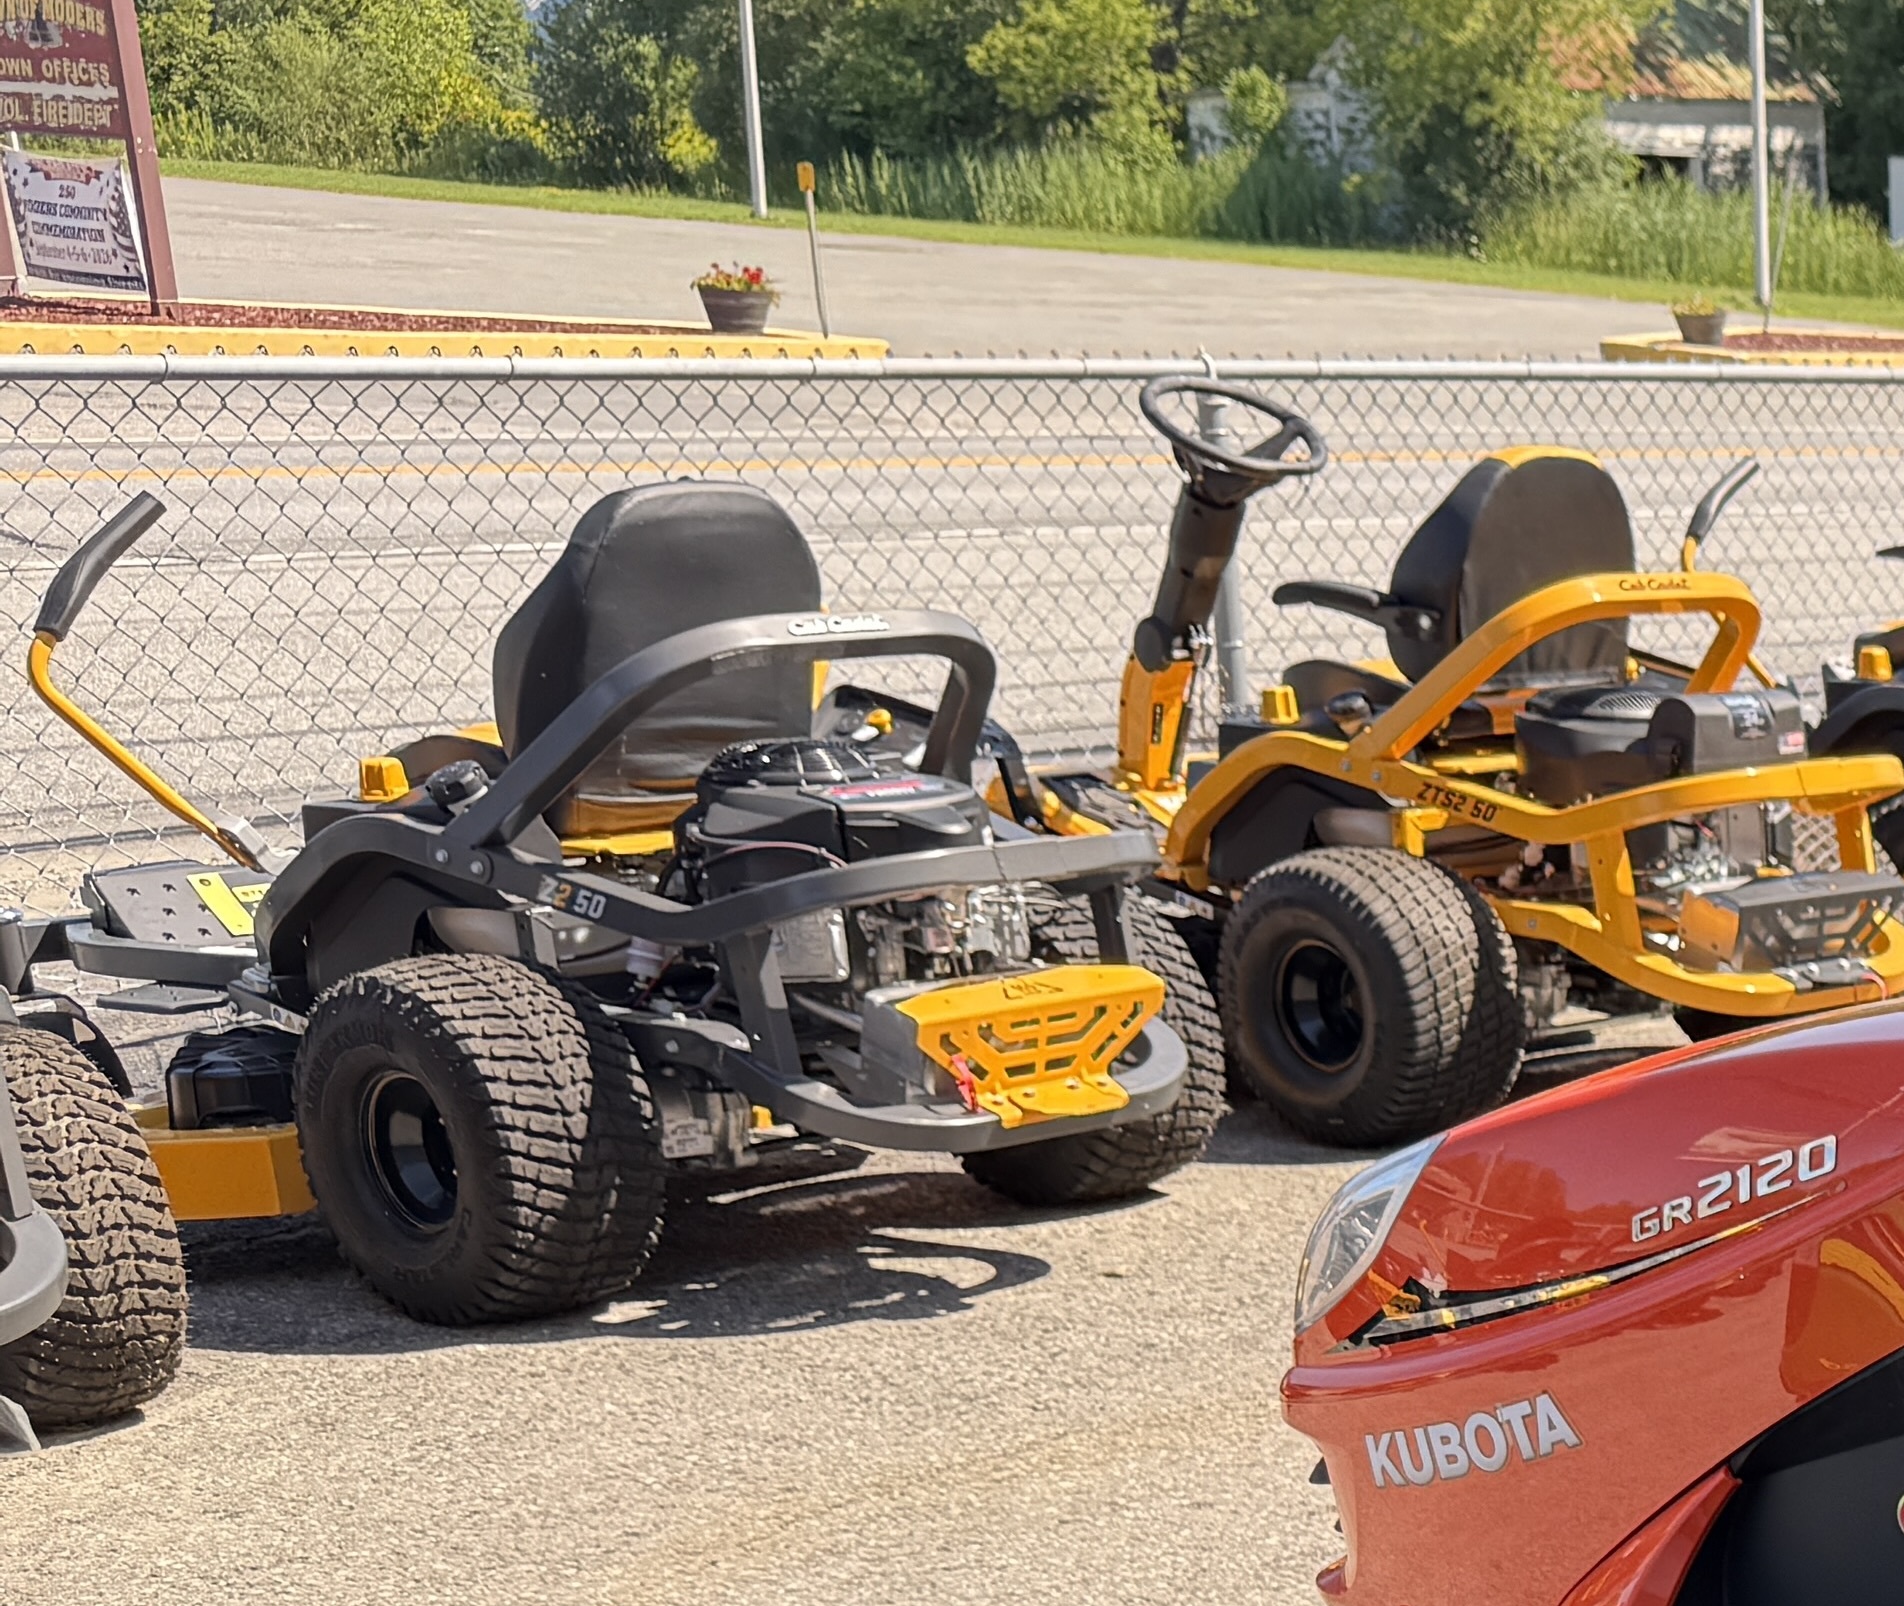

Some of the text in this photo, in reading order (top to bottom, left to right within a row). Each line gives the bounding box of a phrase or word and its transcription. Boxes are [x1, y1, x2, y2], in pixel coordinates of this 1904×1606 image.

[1417, 781, 1468, 812] ZTS2
[573, 889, 607, 919] 50
[1630, 1134, 1838, 1243] GR2120
[1364, 1393, 1582, 1488] KUBOTA
